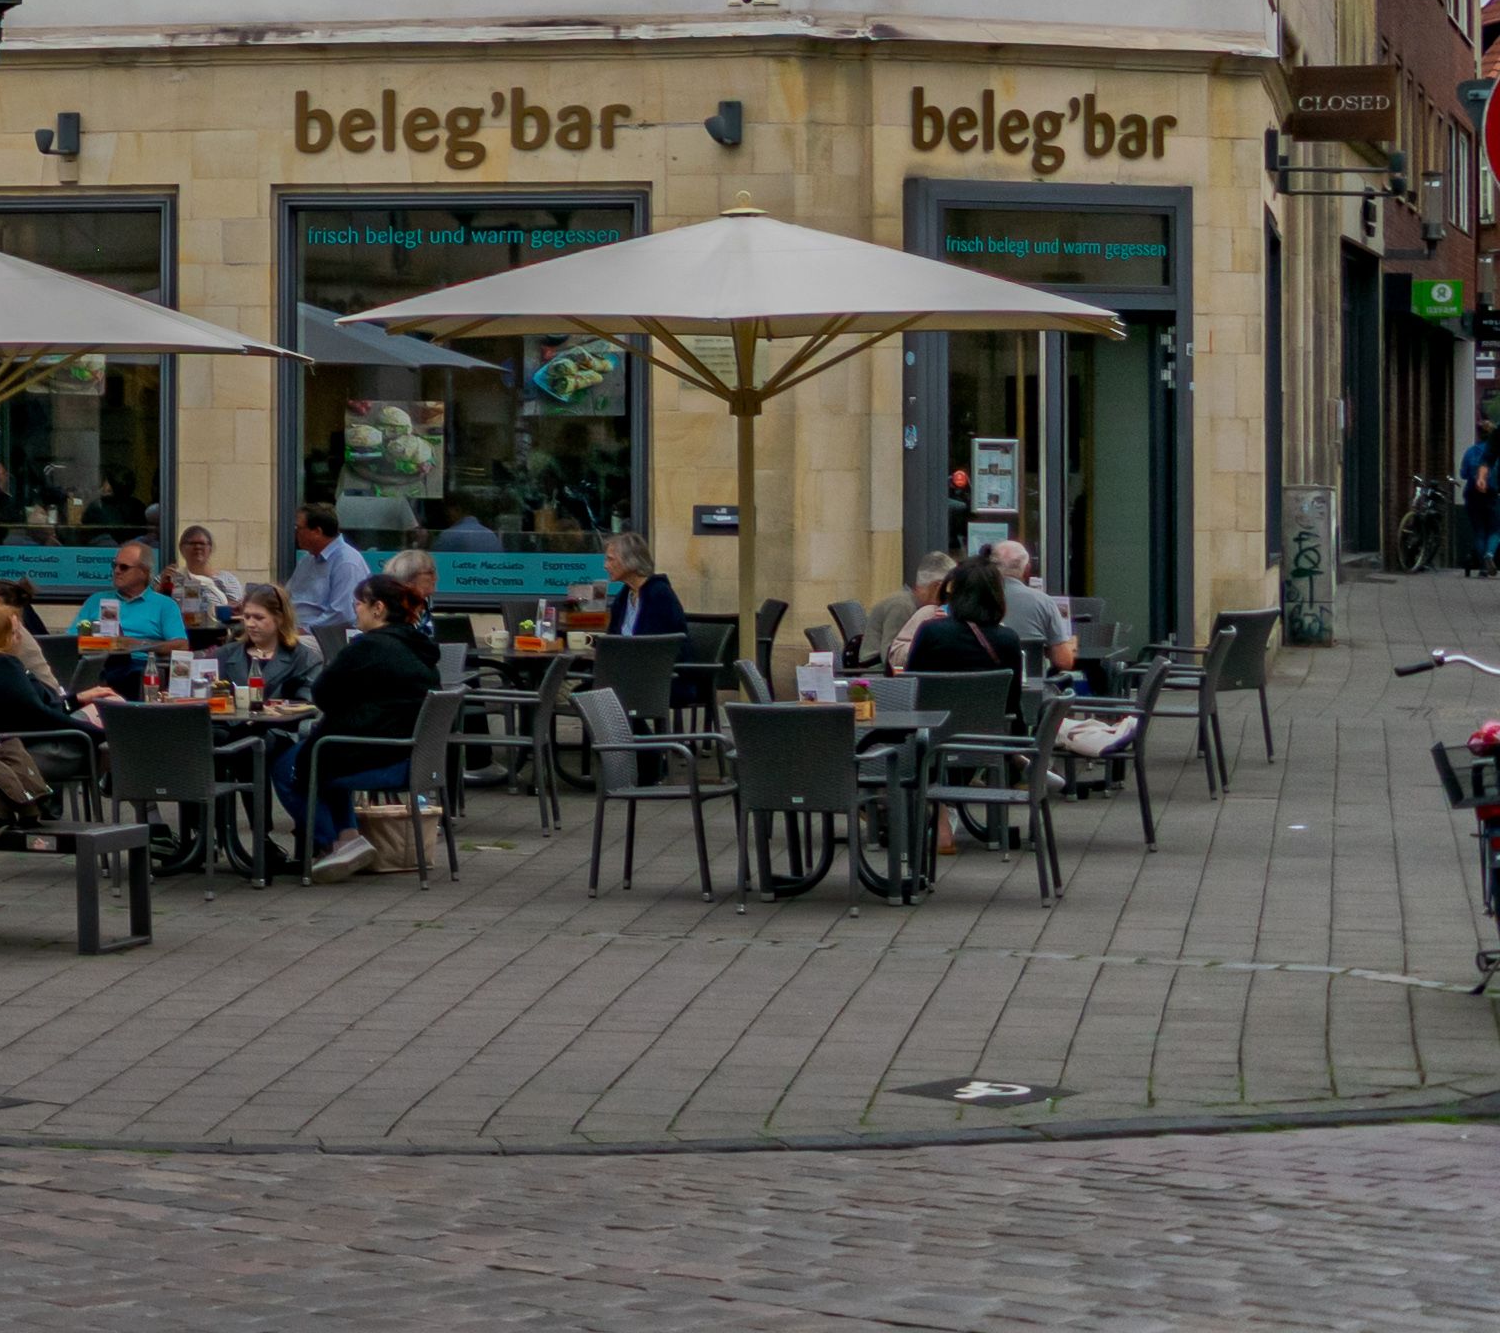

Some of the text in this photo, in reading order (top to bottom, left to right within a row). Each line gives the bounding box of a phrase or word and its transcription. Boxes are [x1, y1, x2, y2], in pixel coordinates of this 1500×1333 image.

[1298, 95, 1390, 111] CLOSED
[295, 87, 631, 169] beleg'bar
[912, 86, 1177, 174] beleg'bar
[308, 226, 620, 250] frisch belegt und warm gegessen
[946, 235, 1167, 260] frisch belegt und warm gegessen
